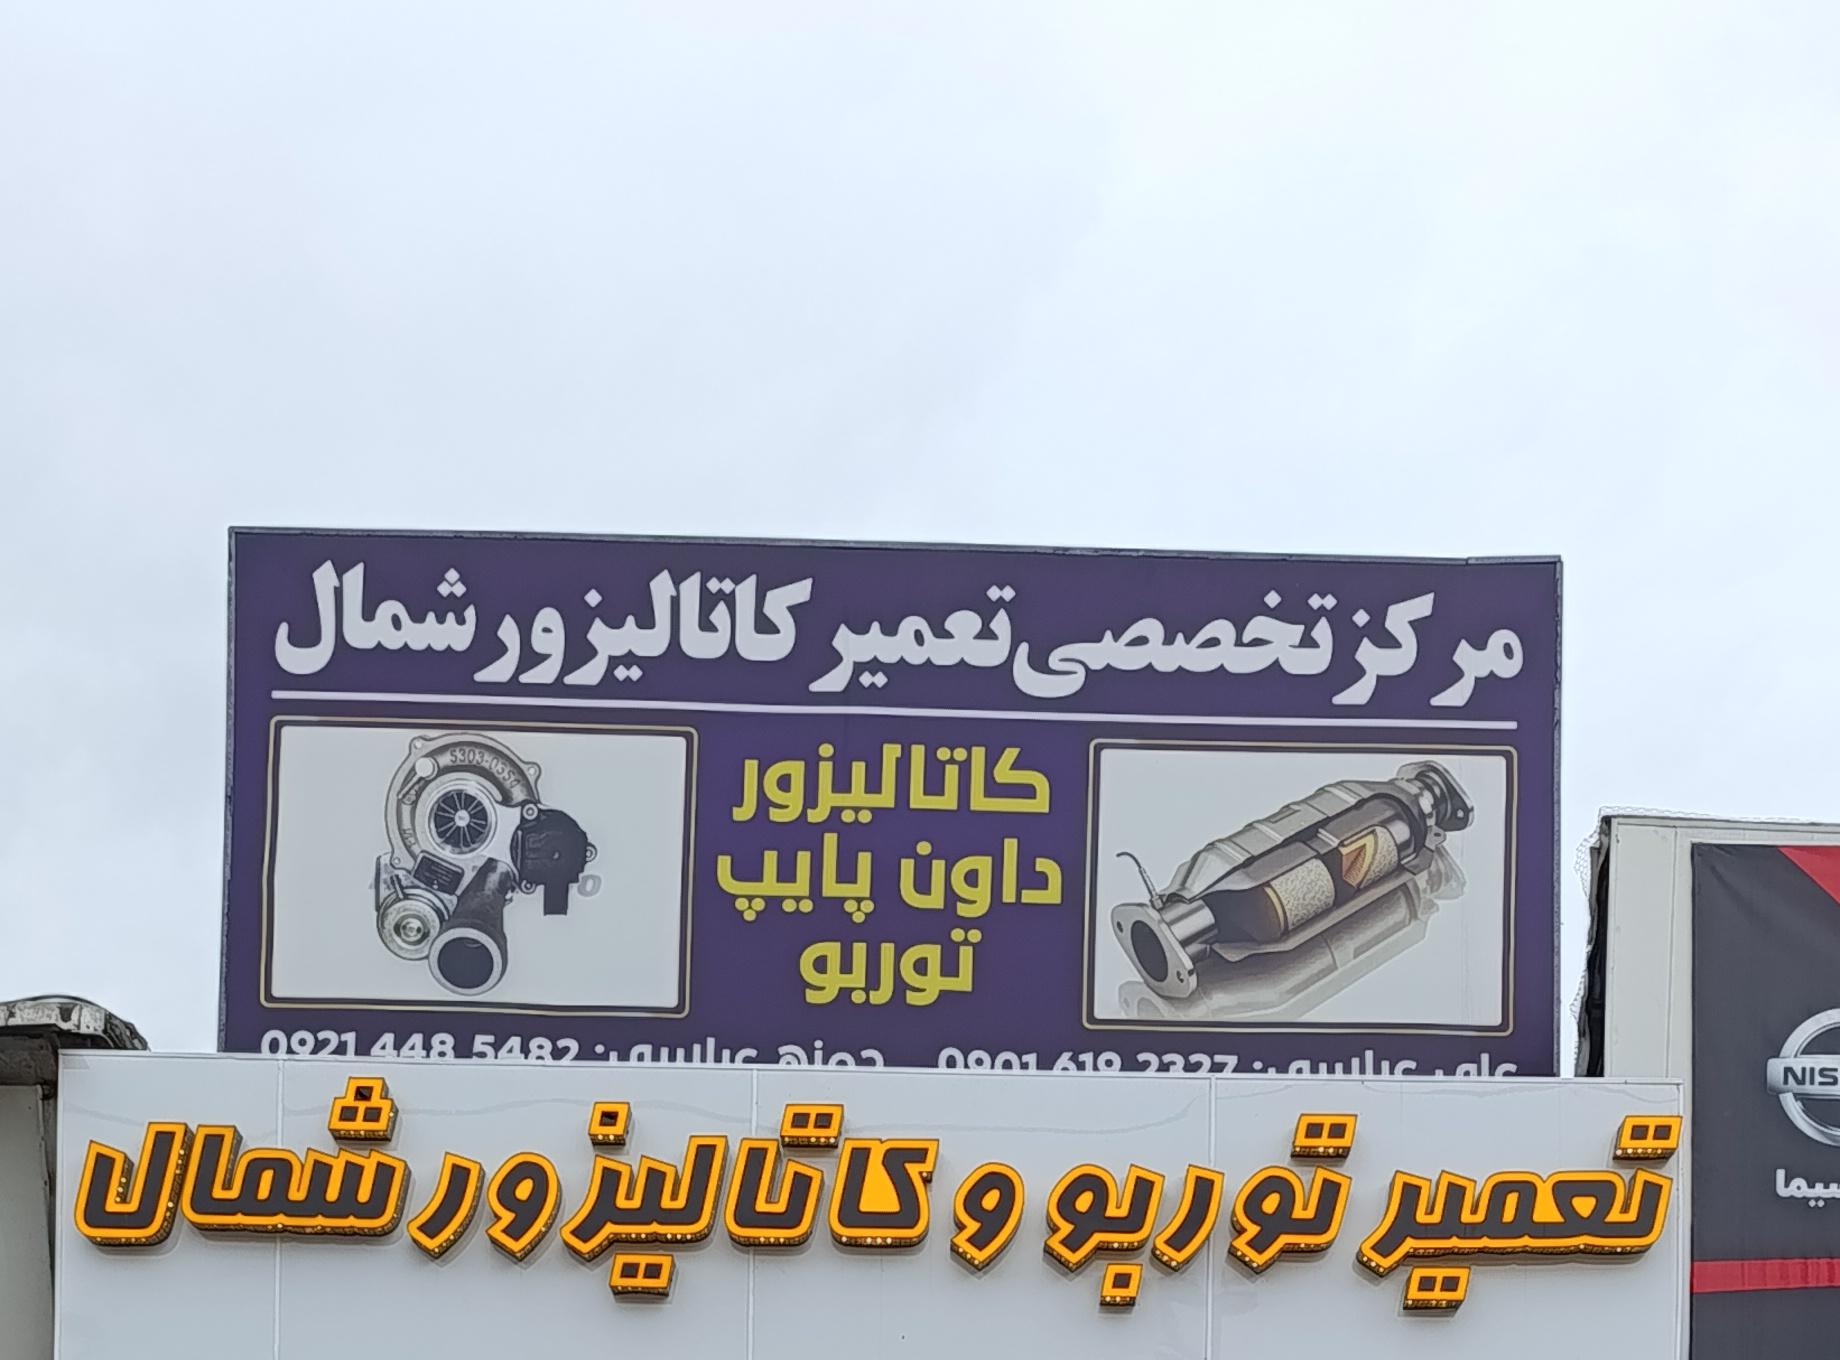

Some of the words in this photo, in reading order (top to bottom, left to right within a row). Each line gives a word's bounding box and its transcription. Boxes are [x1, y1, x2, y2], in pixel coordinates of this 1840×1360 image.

[275, 560, 476, 675] شمال
[473, 569, 812, 685] کاتالیزور
[808, 585, 1015, 692] تعمیر
[1013, 590, 1337, 698] تخصصی
[1332, 592, 1524, 706] مرکز
[732, 743, 1050, 823] کاتالیزور
[716, 832, 875, 923] پایپ
[900, 837, 1063, 918] داون
[799, 927, 982, 1006] توربو
[1783, 1066, 1840, 1086] NIS
[75, 1077, 411, 1248] شمال
[408, 1102, 939, 1299] کاتالیزور
[950, 1162, 1024, 1271] و
[1043, 1112, 1358, 1309] توربو
[1356, 1114, 1683, 1311] تعمیر
